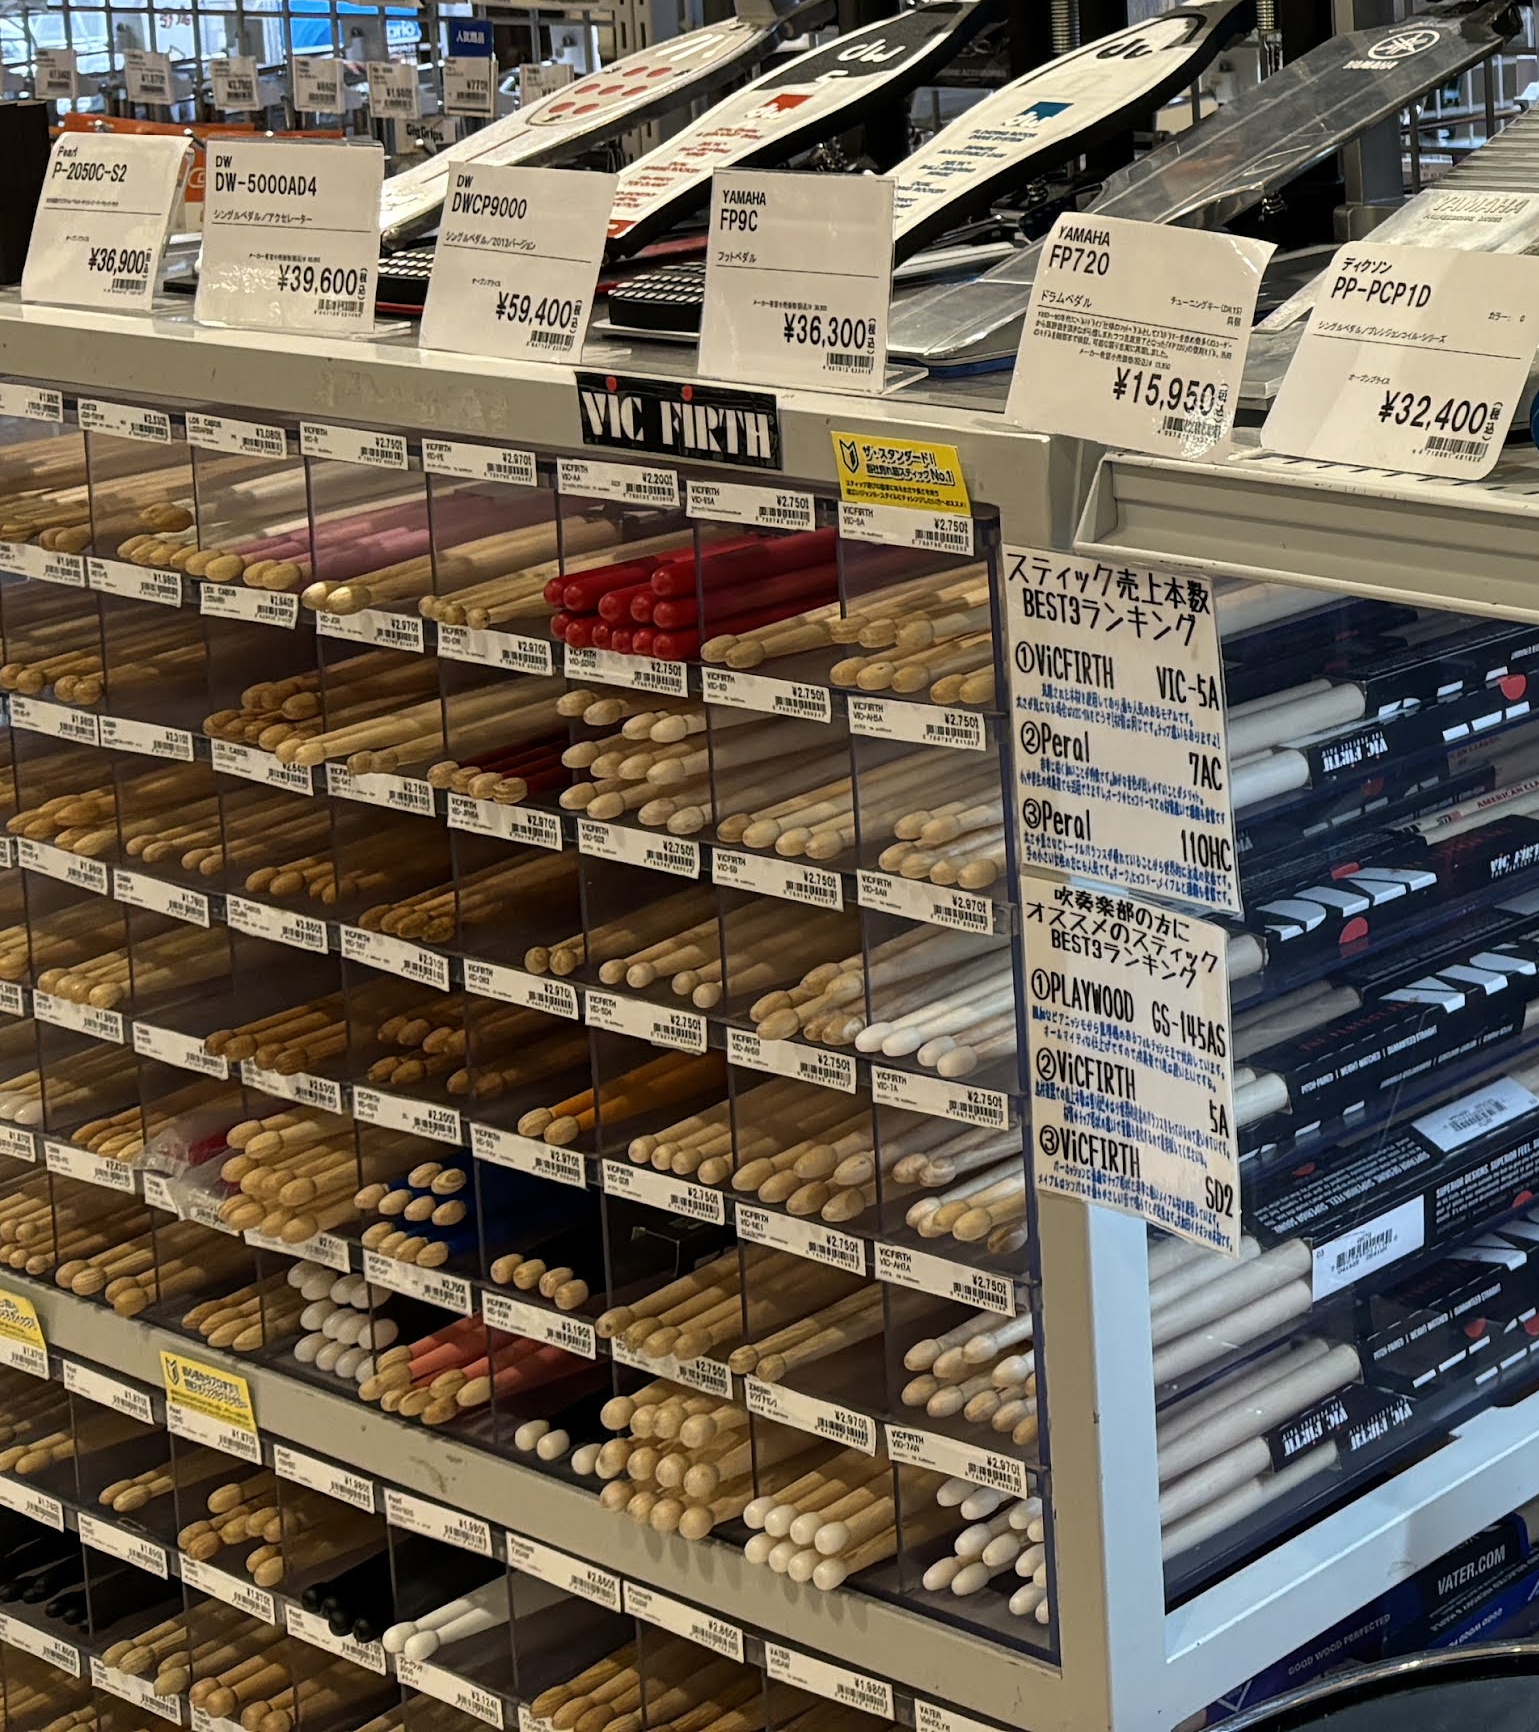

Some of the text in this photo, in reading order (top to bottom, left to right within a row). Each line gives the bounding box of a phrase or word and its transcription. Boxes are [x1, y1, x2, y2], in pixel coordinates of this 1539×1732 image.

[52, 161, 127, 183] P-2050C-S2
[215, 155, 232, 167] DW
[215, 173, 317, 196] DW-5000AD4
[457, 174, 474, 188] DW
[722, 189, 767, 207] YAMAHA
[452, 191, 528, 220] DWCP9000
[720, 208, 758, 232] FP9C
[1058, 225, 1111, 247] YAMAHA
[88, 247, 145, 275] ¥36,900
[717, 250, 757, 264] フットペダル
[1049, 244, 1110, 276] FP720
[1342, 256, 1394, 275] ディクソン
[277, 264, 357, 296] ¥39,600
[1041, 290, 1092, 308] ドラムペダル
[1330, 276, 1433, 309] PP-PCP1D
[495, 291, 572, 329] ¥59,400
[783, 312, 867, 350] ¥36,300
[1113, 366, 1215, 417] ¥15,950
[581, 376, 776, 459] VIC FIRTH
[1377, 389, 1490, 437] ¥32,400
[1006, 553, 1210, 616] スティック売上本数
[1023, 588, 1196, 646] BEST3ランキング
[1156, 666, 1220, 711] VIC-5A
[1189, 752, 1223, 791] 7AC
[1181, 830, 1232, 872] 110HC
[1054, 885, 1190, 943] 吹奏楽部の方に
[1026, 902, 1218, 973] オススメのスティック
[1051, 930, 1197, 988] BEST3ランキング
[1152, 1001, 1226, 1058] GS-145AS
[1209, 1099, 1230, 1139] 5A
[1205, 1175, 1234, 1218] SD2
